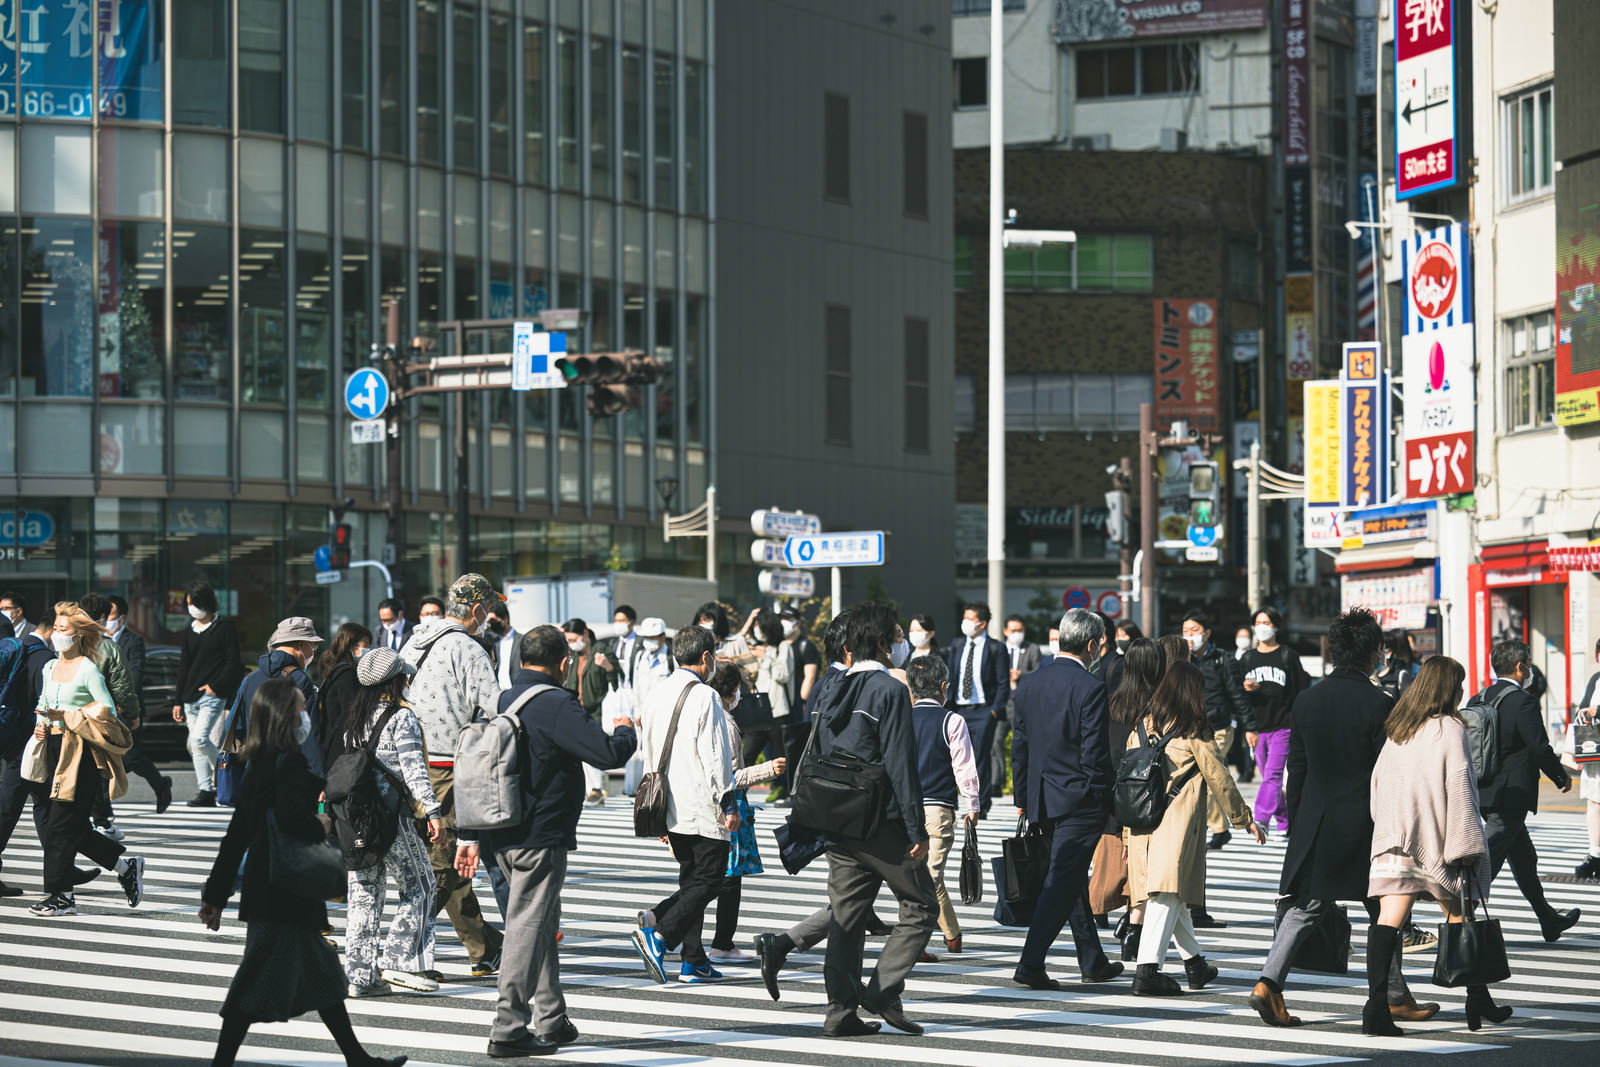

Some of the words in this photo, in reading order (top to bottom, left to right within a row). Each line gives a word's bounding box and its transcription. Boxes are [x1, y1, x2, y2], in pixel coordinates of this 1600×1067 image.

[1405, 0, 1444, 42] 学校
[1159, 301, 1184, 400] トミンズ
[1432, 438, 1468, 491] すぐ
